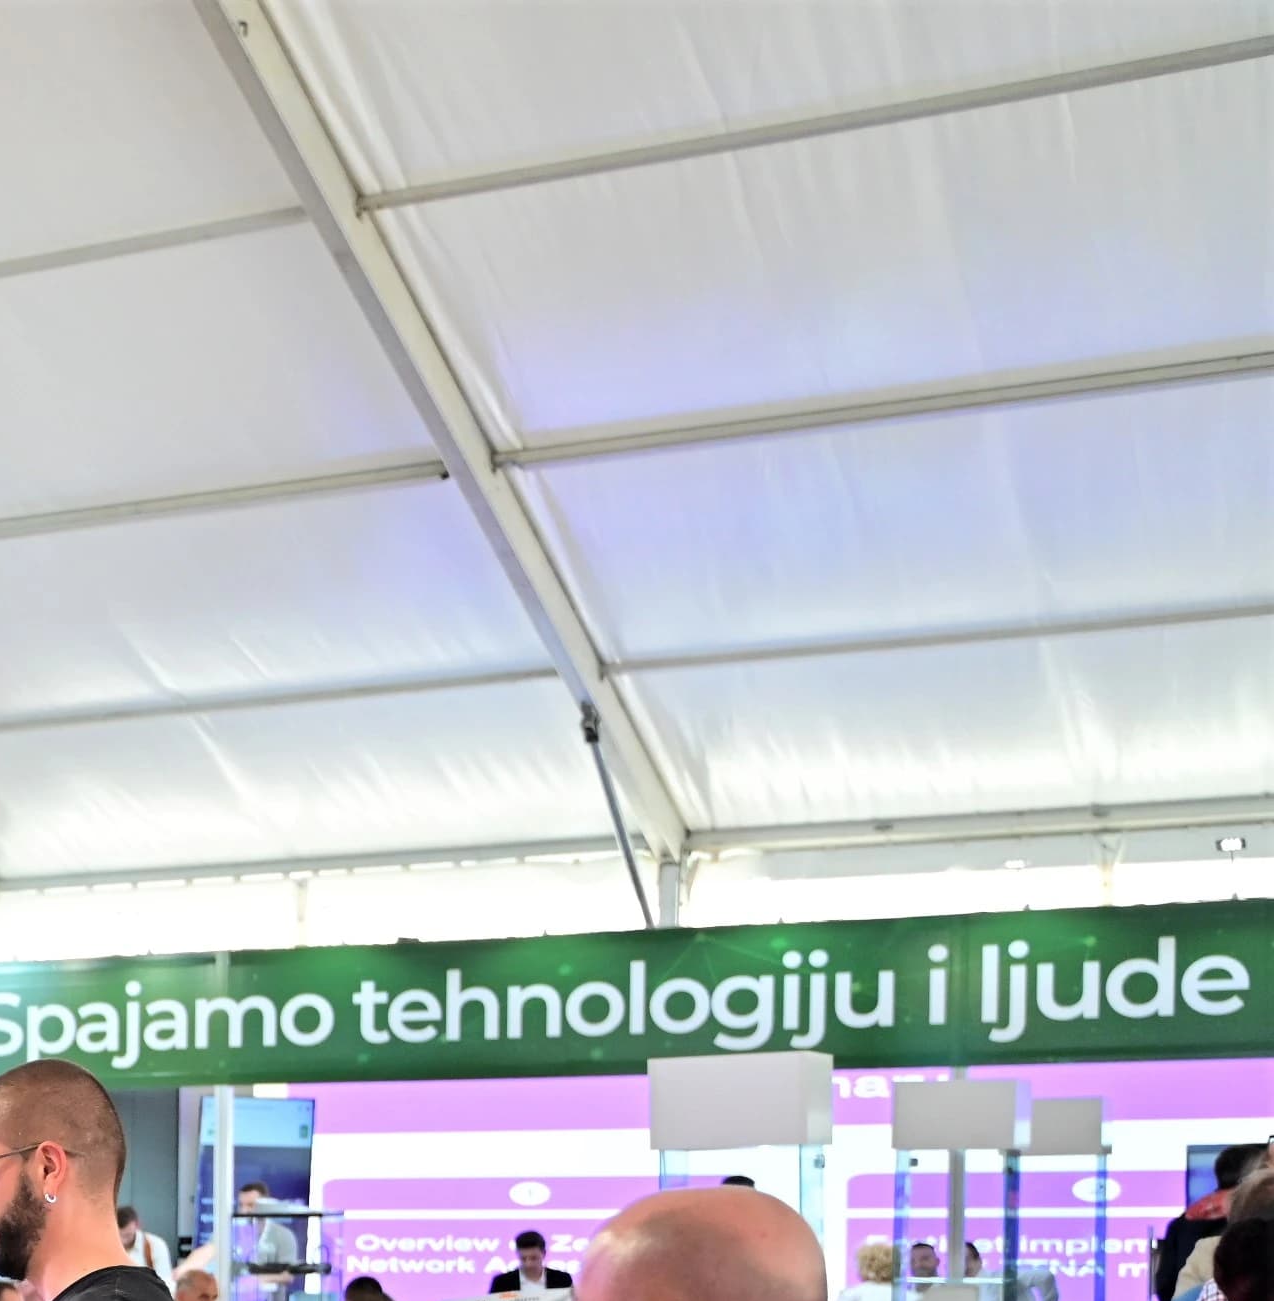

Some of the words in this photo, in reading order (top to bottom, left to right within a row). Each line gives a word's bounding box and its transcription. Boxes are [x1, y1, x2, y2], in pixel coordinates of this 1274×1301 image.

[352, 949, 895, 1051] tehnologiju
[928, 945, 949, 1025] i
[981, 936, 1251, 1043] ljude
[354, 1234, 499, 1252] Overview
[347, 1256, 475, 1275] Network
